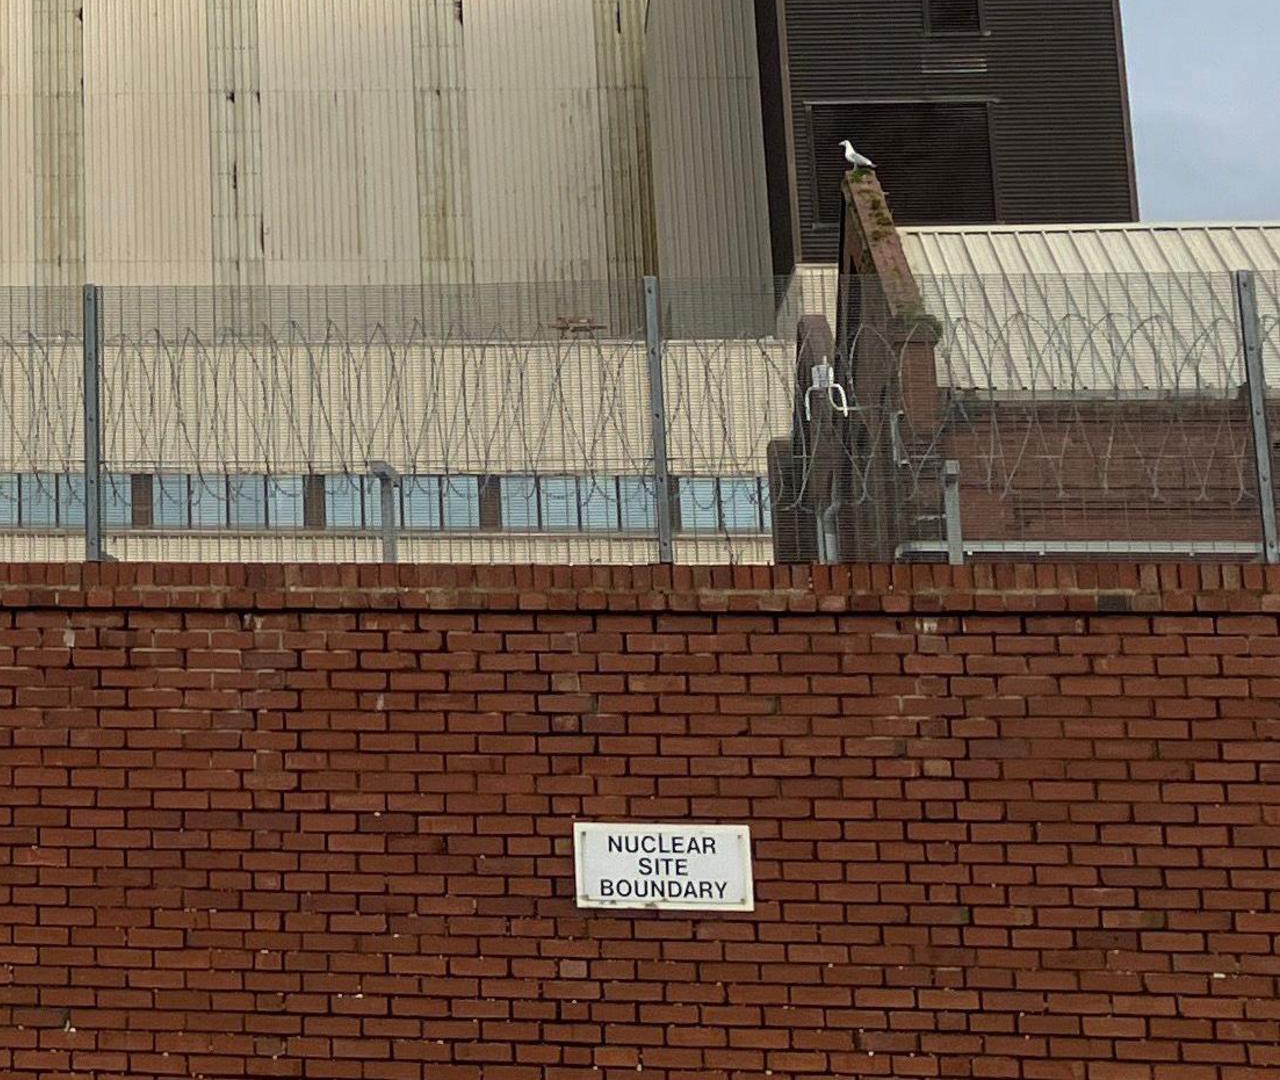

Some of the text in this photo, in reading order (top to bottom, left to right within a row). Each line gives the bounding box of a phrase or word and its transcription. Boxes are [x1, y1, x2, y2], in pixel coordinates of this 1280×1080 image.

[608, 834, 716, 854] NUCLEAR
[639, 858, 688, 876] SITE
[600, 879, 728, 899] BOUNDARY
